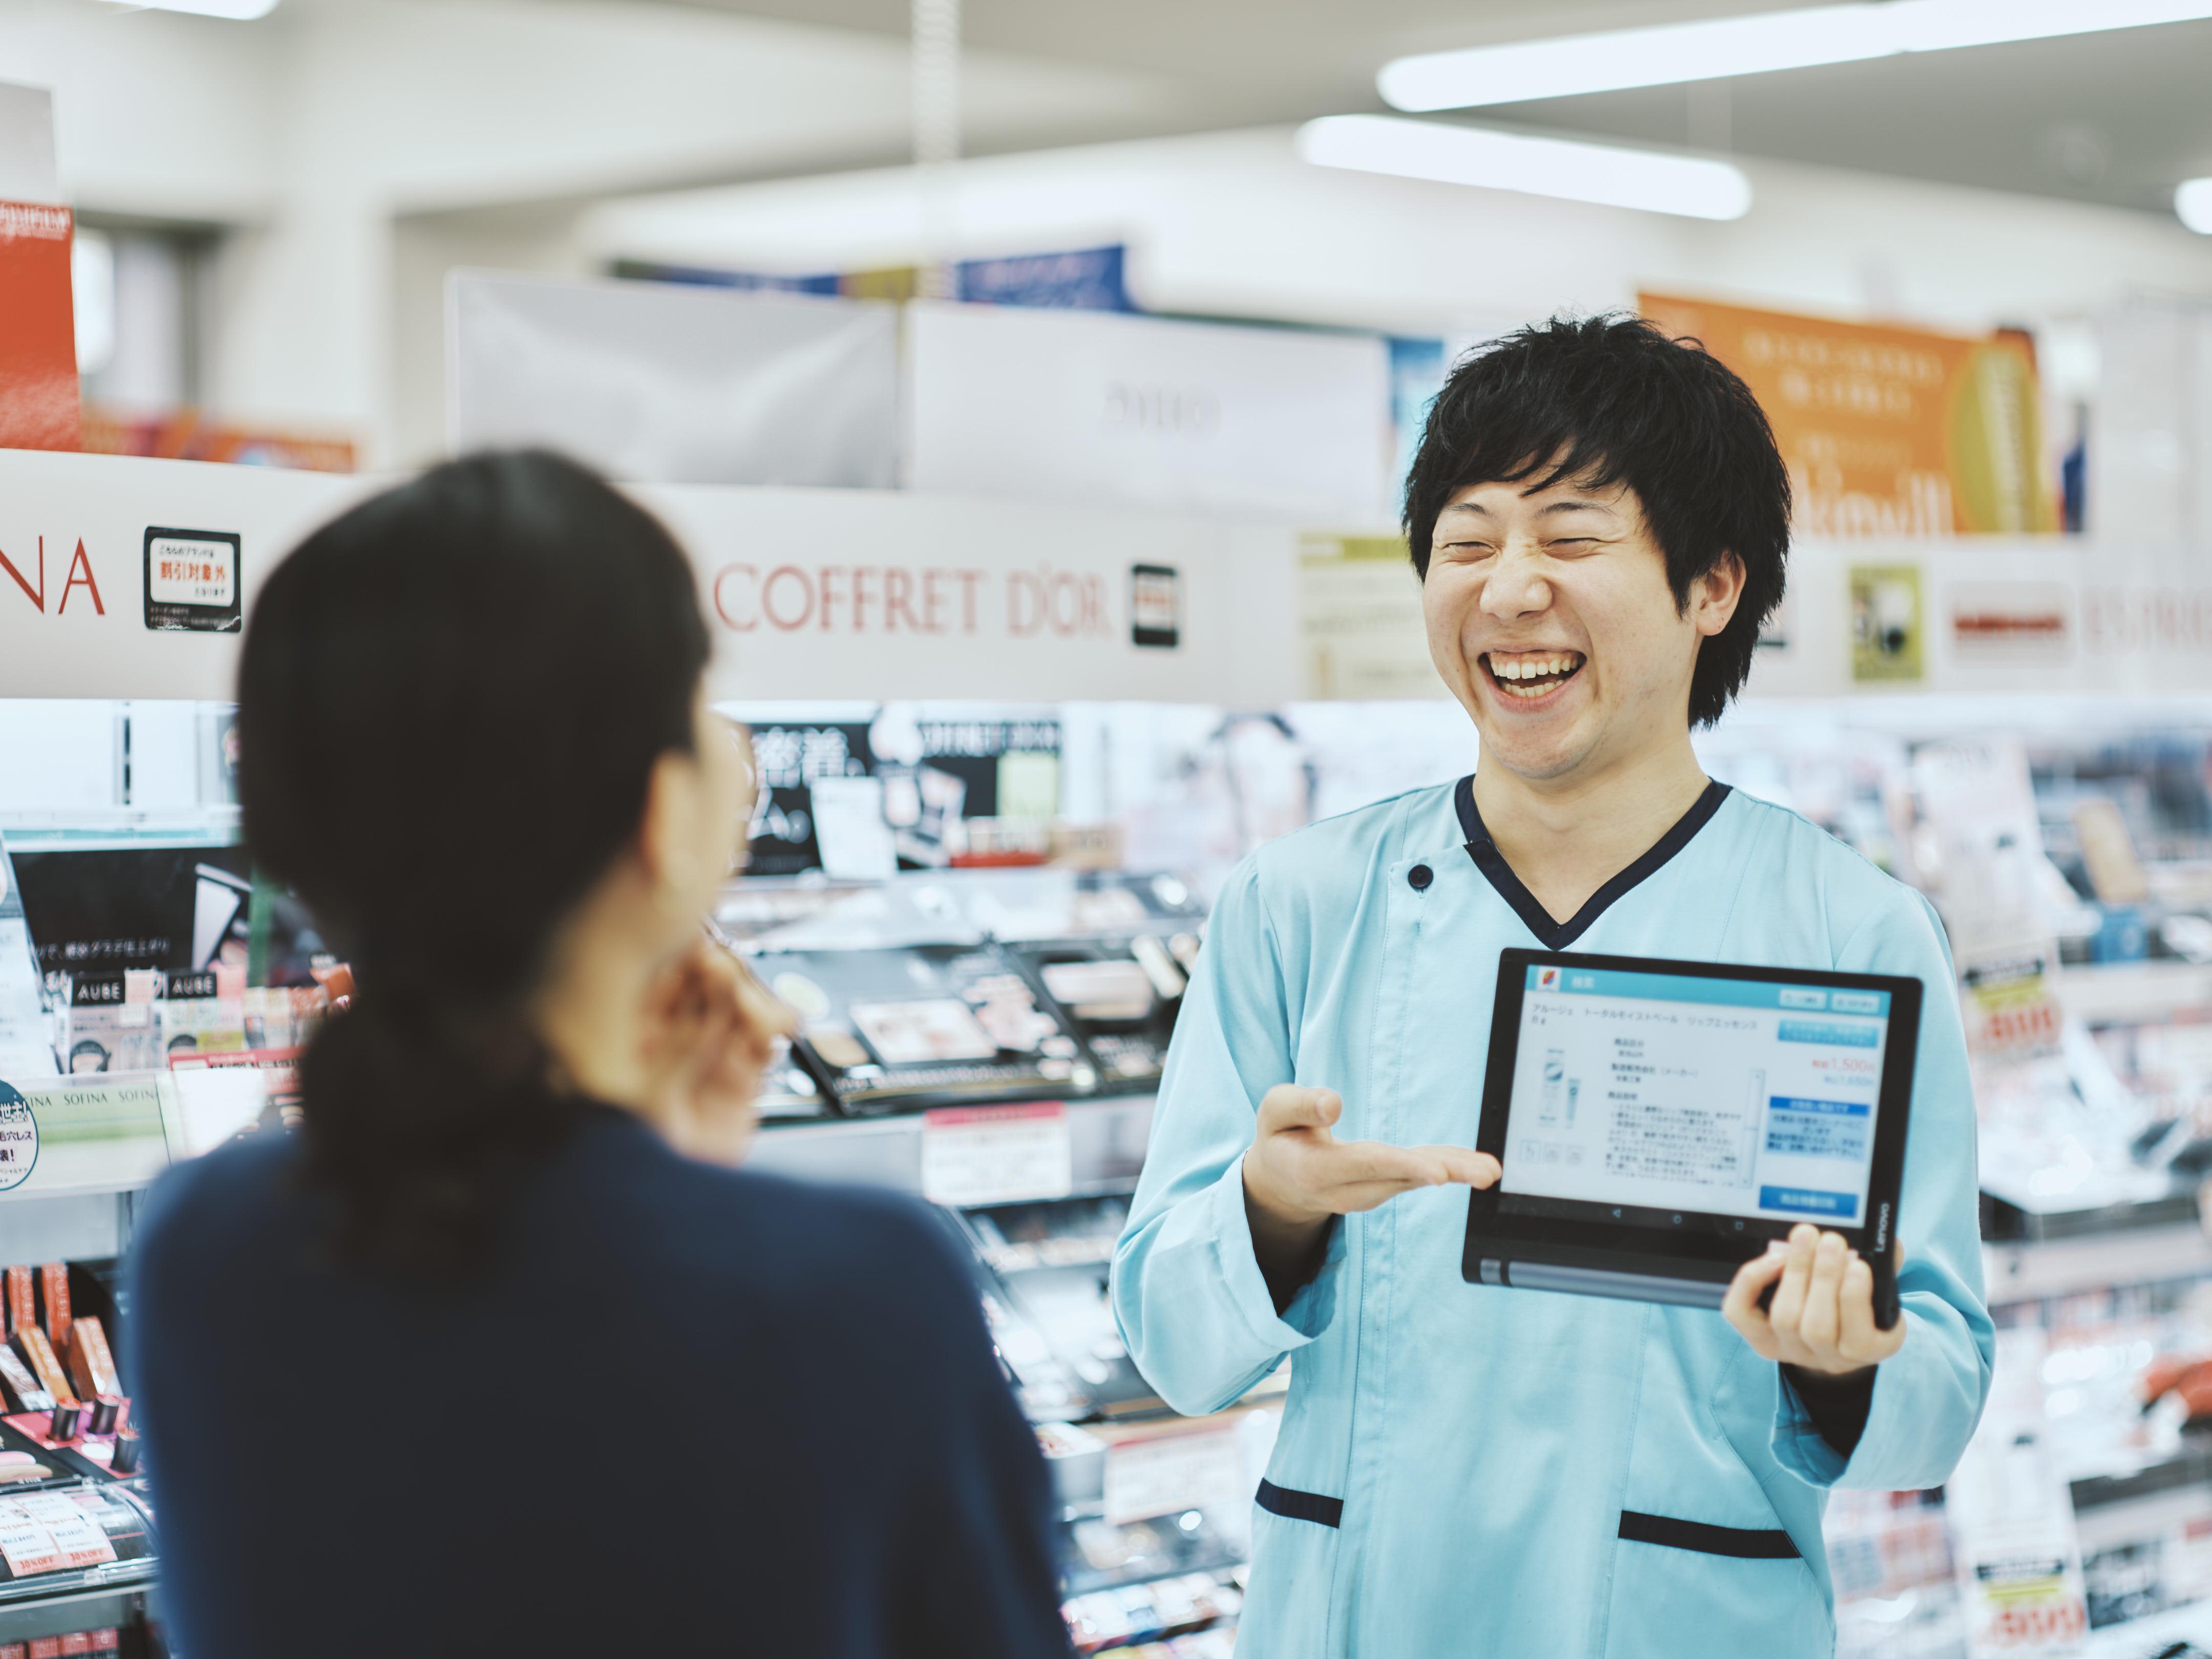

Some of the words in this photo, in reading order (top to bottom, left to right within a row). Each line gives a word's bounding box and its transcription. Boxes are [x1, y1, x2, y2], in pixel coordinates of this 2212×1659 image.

[160, 561, 225, 582] 割引対象外
[713, 562, 984, 635] COFFRET
[77, 982, 121, 1001] AUBE
[172, 975, 214, 994] AUBE
[1533, 1004, 1573, 1016] アルージェ
[64, 1091, 108, 1107] SOFINA
[1874, 1203, 1890, 1252] Lenovo
